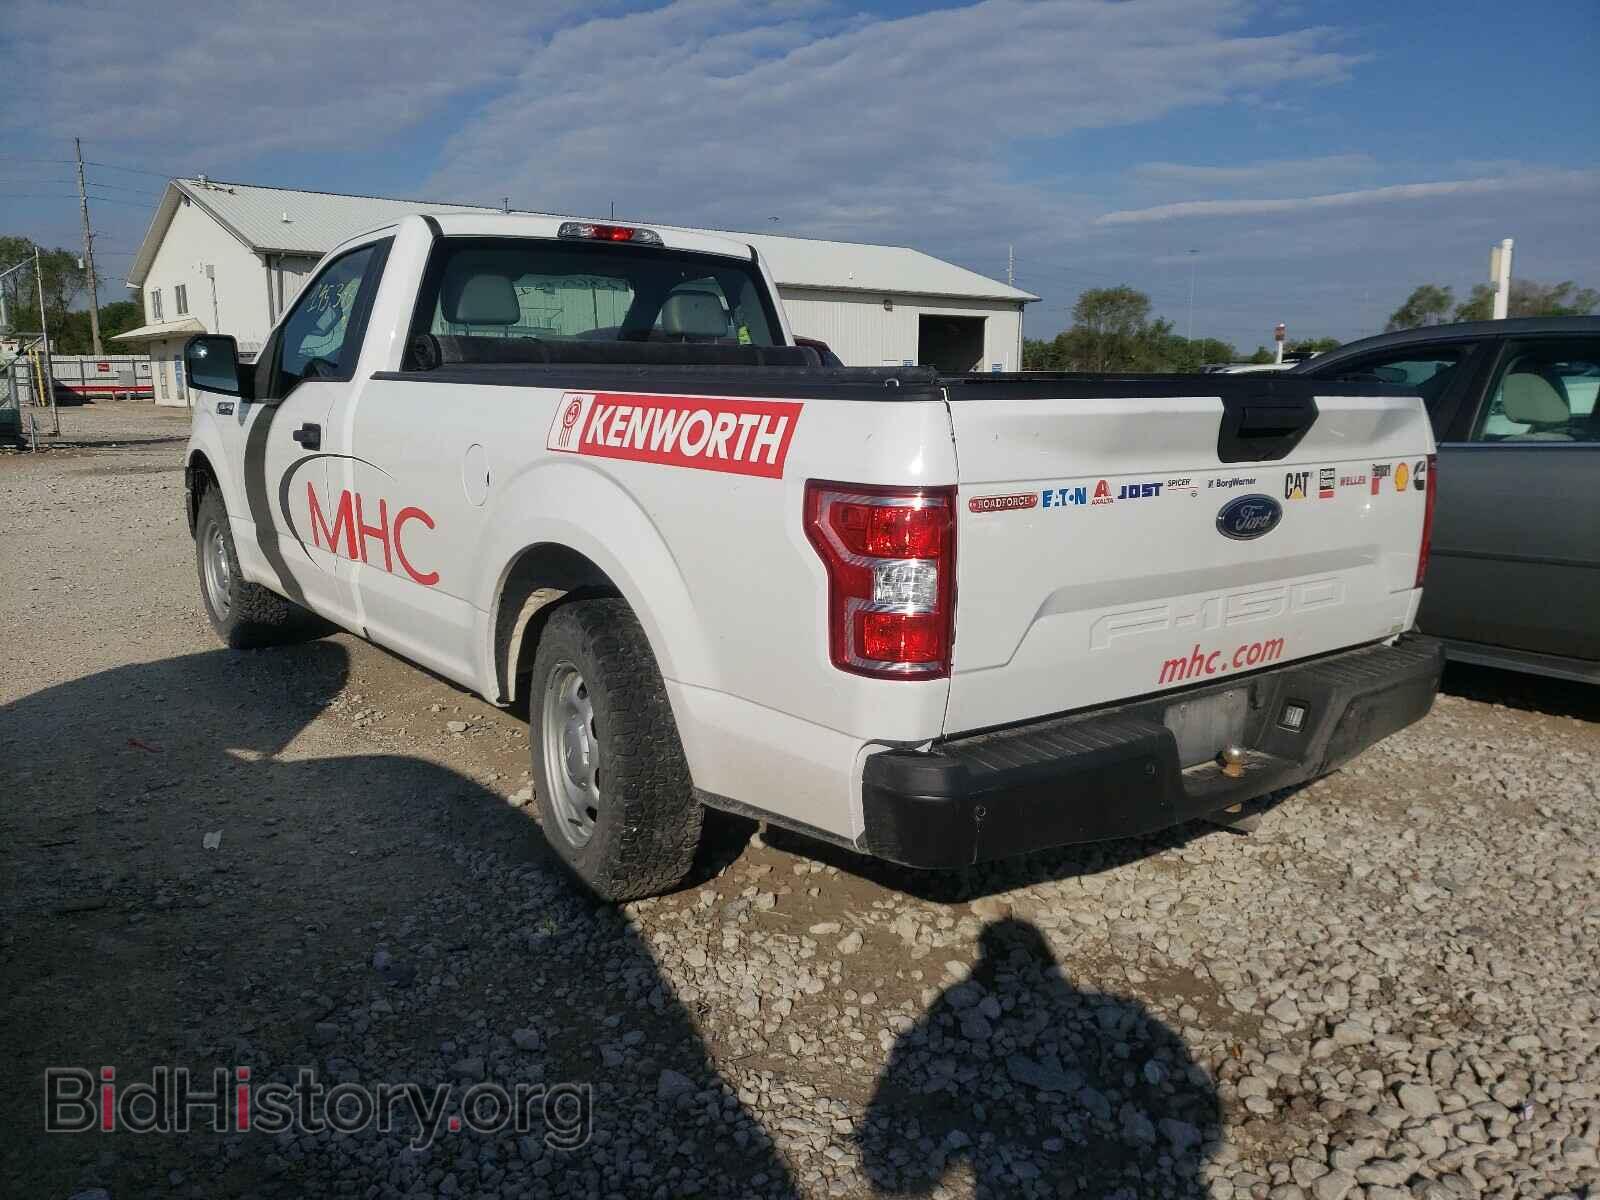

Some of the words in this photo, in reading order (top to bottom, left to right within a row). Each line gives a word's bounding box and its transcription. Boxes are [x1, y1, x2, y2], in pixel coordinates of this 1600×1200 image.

[585, 404, 788, 464] KENWORTH
[1118, 483, 1163, 499] JOST
[1216, 478, 1256, 488] BorgWarner
[1285, 471, 1310, 500] CAT
[977, 496, 1029, 509] ROADFORCE
[1235, 504, 1272, 530] Ford
[307, 481, 440, 586] MHC
[1089, 576, 1346, 651] F-150
[1158, 637, 1285, 684] mhc.com
